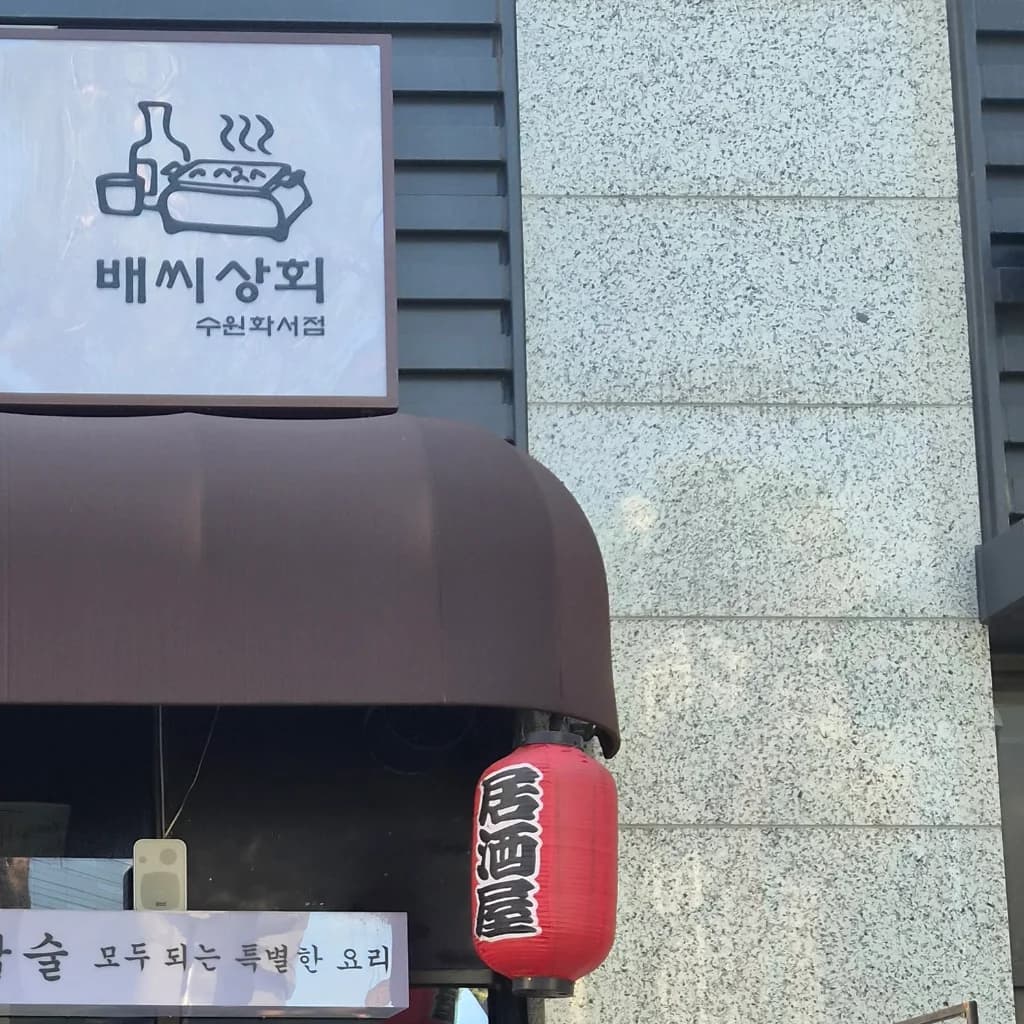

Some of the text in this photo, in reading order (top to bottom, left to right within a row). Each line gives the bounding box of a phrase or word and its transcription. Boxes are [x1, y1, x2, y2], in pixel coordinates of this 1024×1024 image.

[96, 256, 325, 305] 배씨상회
[195, 315, 326, 337] 수원화서점
[475, 762, 544, 942] 居酒屋
[94, 943, 151, 971] 모두
[164, 943, 222, 972] 되는
[235, 943, 323, 973] 특별한
[336, 945, 390, 973] 요리
